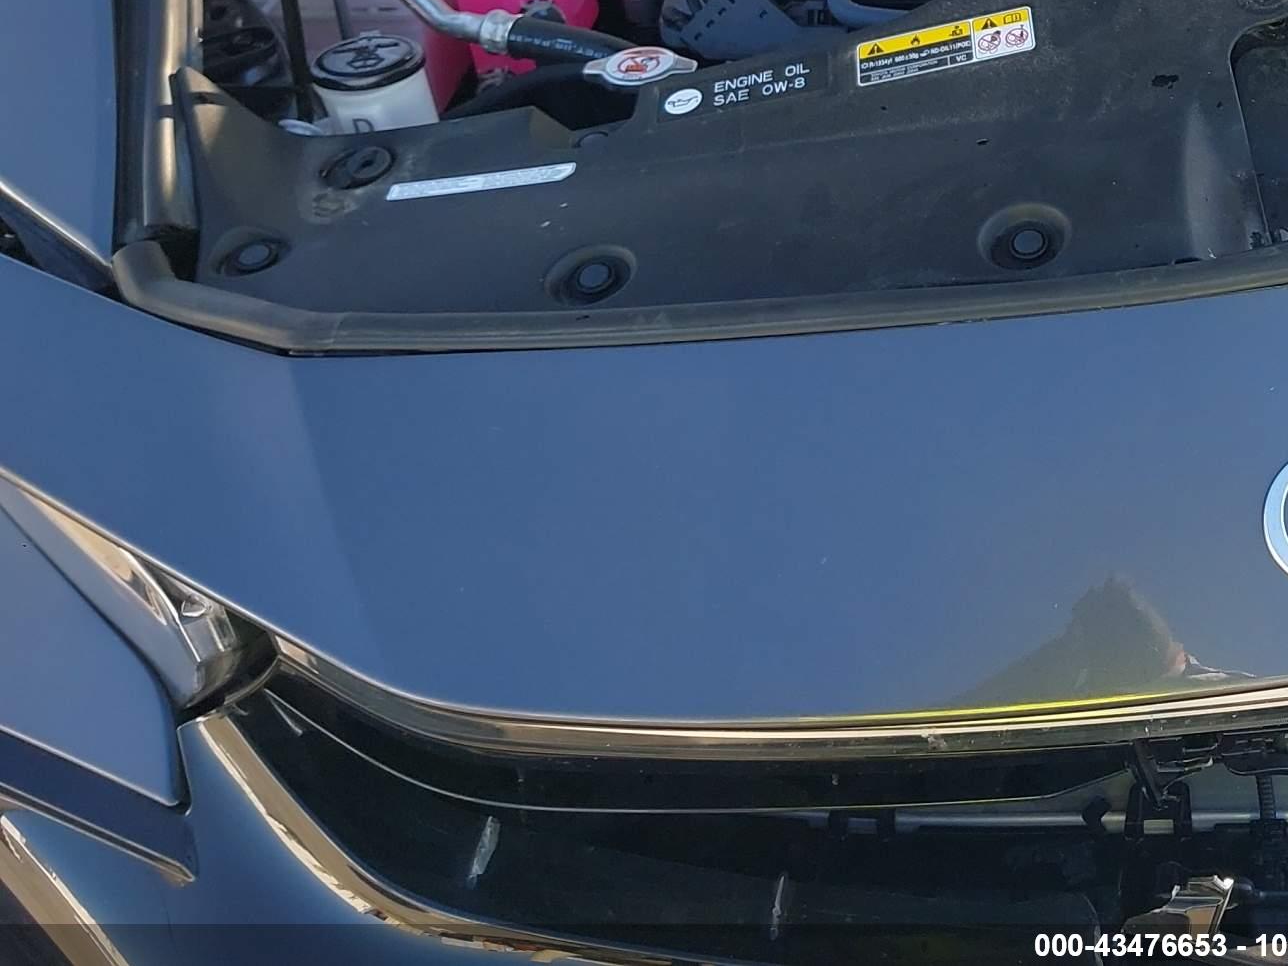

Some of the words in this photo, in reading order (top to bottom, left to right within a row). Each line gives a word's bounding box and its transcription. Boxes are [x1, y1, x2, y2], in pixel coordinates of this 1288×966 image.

[713, 70, 774, 94] ENGINE
[785, 63, 811, 78] OIL
[713, 88, 750, 107] SAE
